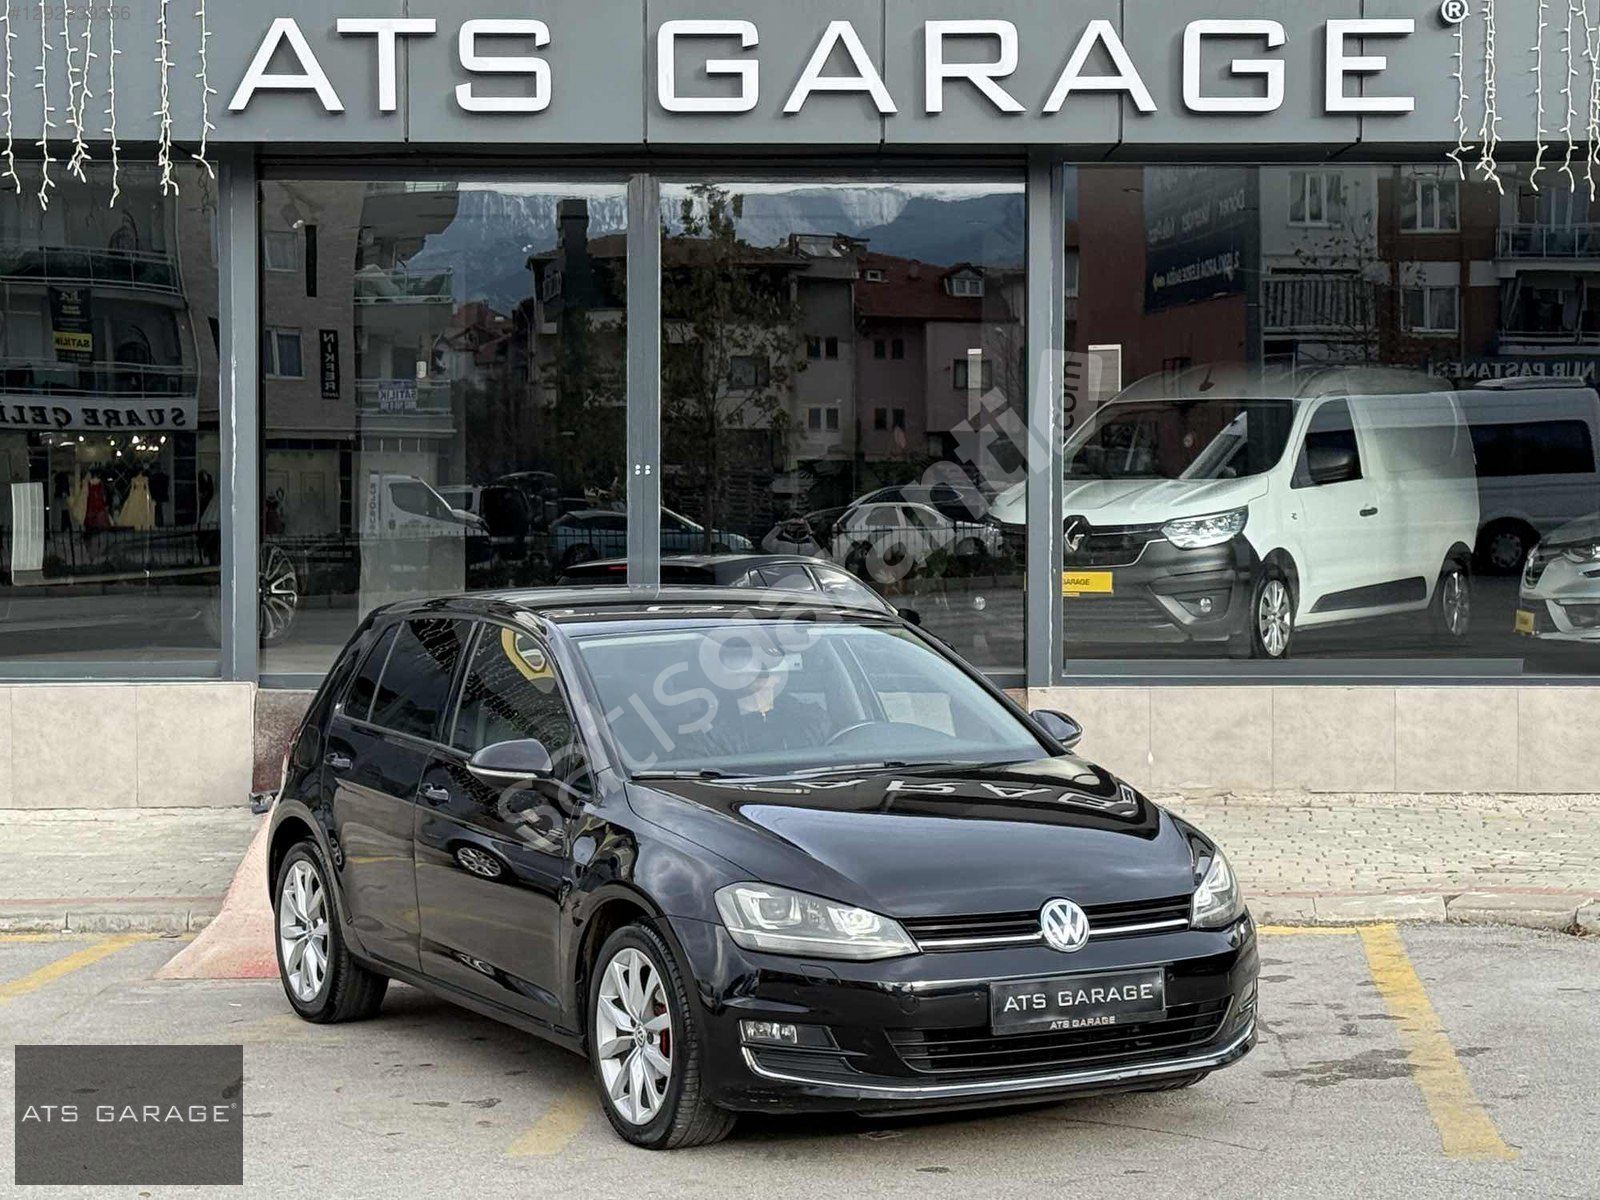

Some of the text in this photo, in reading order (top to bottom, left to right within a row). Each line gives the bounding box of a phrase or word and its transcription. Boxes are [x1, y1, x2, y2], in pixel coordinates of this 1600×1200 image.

[228, 18, 551, 113] ATS
[657, 18, 1416, 113] GARAGE
[1003, 983, 1154, 1012] ATS GARAGE
[1050, 1016, 1116, 1030] ATS GARAGE
